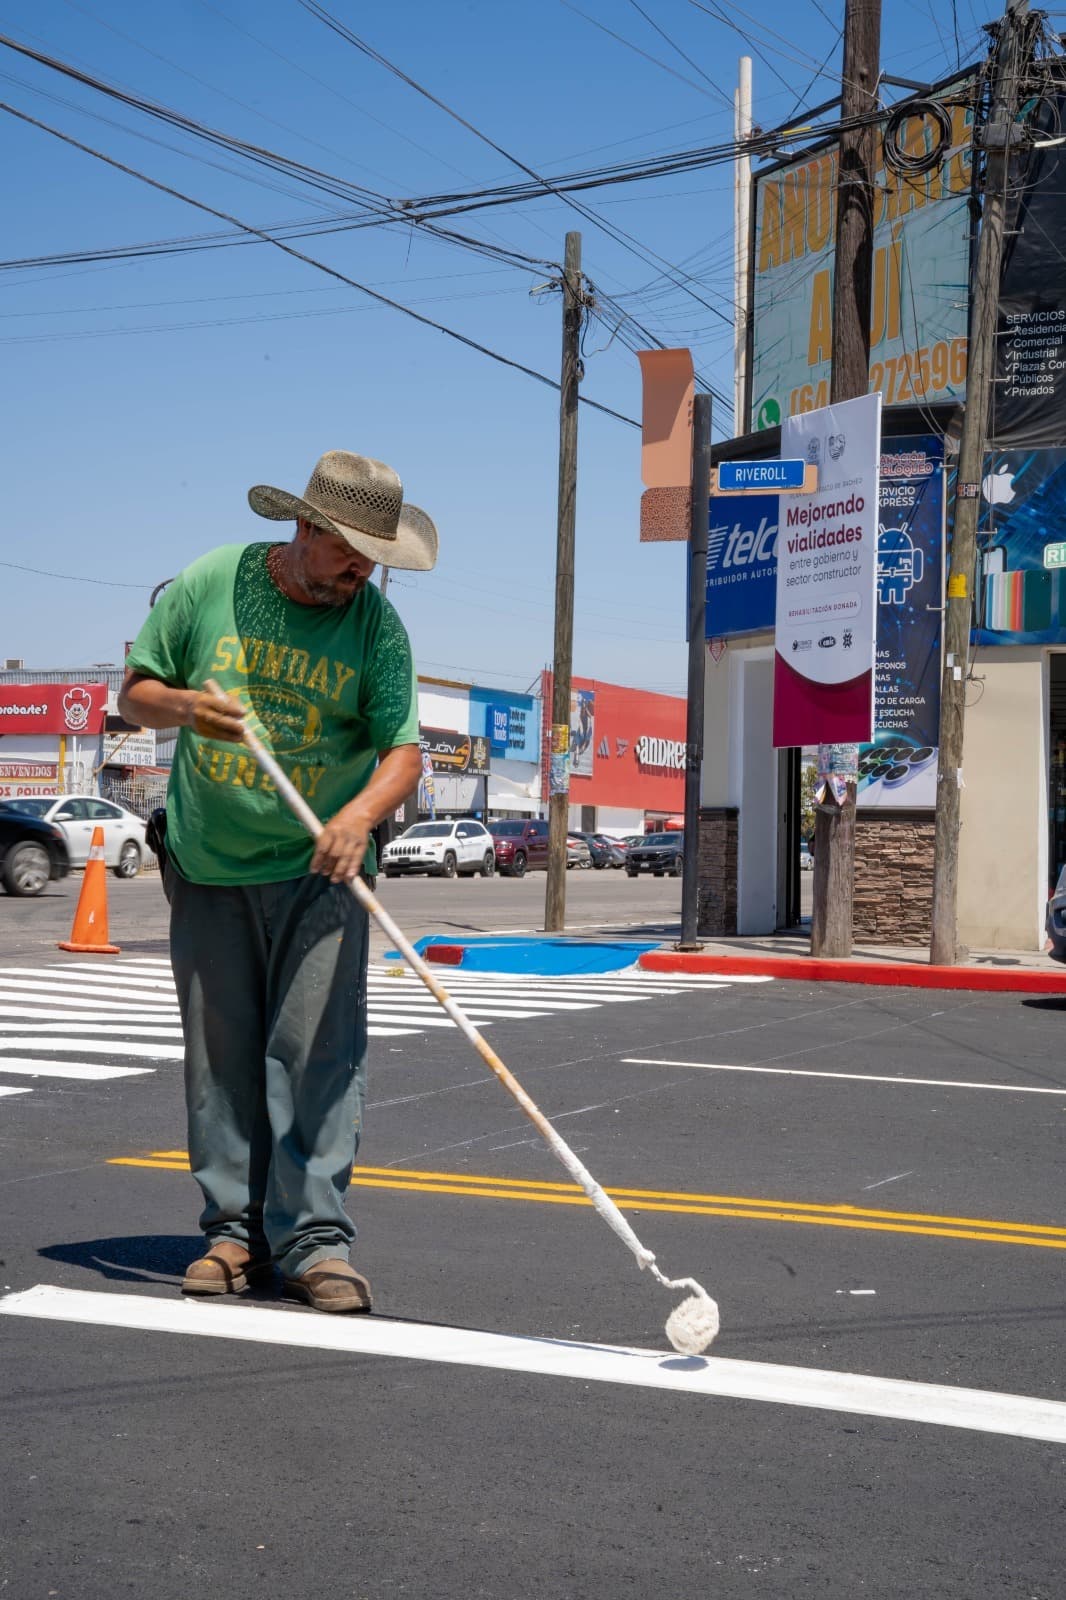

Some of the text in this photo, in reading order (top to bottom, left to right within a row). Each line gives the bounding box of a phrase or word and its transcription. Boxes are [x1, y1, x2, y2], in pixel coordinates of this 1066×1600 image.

[1006, 310, 1065, 324] SERVICIOS
[1013, 335, 1063, 347] Comercial
[1013, 347, 1058, 360] Industrial
[1012, 362, 1046, 373] Plazas
[1012, 373, 1054, 384] Públicos
[1011, 386, 1055, 396] Privados
[735, 467, 788, 482] RIVEROLL
[880, 462, 934, 477] BLOQUEO
[787, 493, 865, 527] Mejorando
[788, 524, 862, 554] vialidades
[789, 550, 859, 570] entre gobierno y
[786, 566, 862, 587] sector constructor
[788, 601, 858, 617] REHABILITACIÓN DONADA
[211, 635, 356, 702] SUNDAY
[887, 697, 898, 705] DE
[899, 697, 926, 705] CARGA
[880, 709, 915, 717] ESCUCHA
